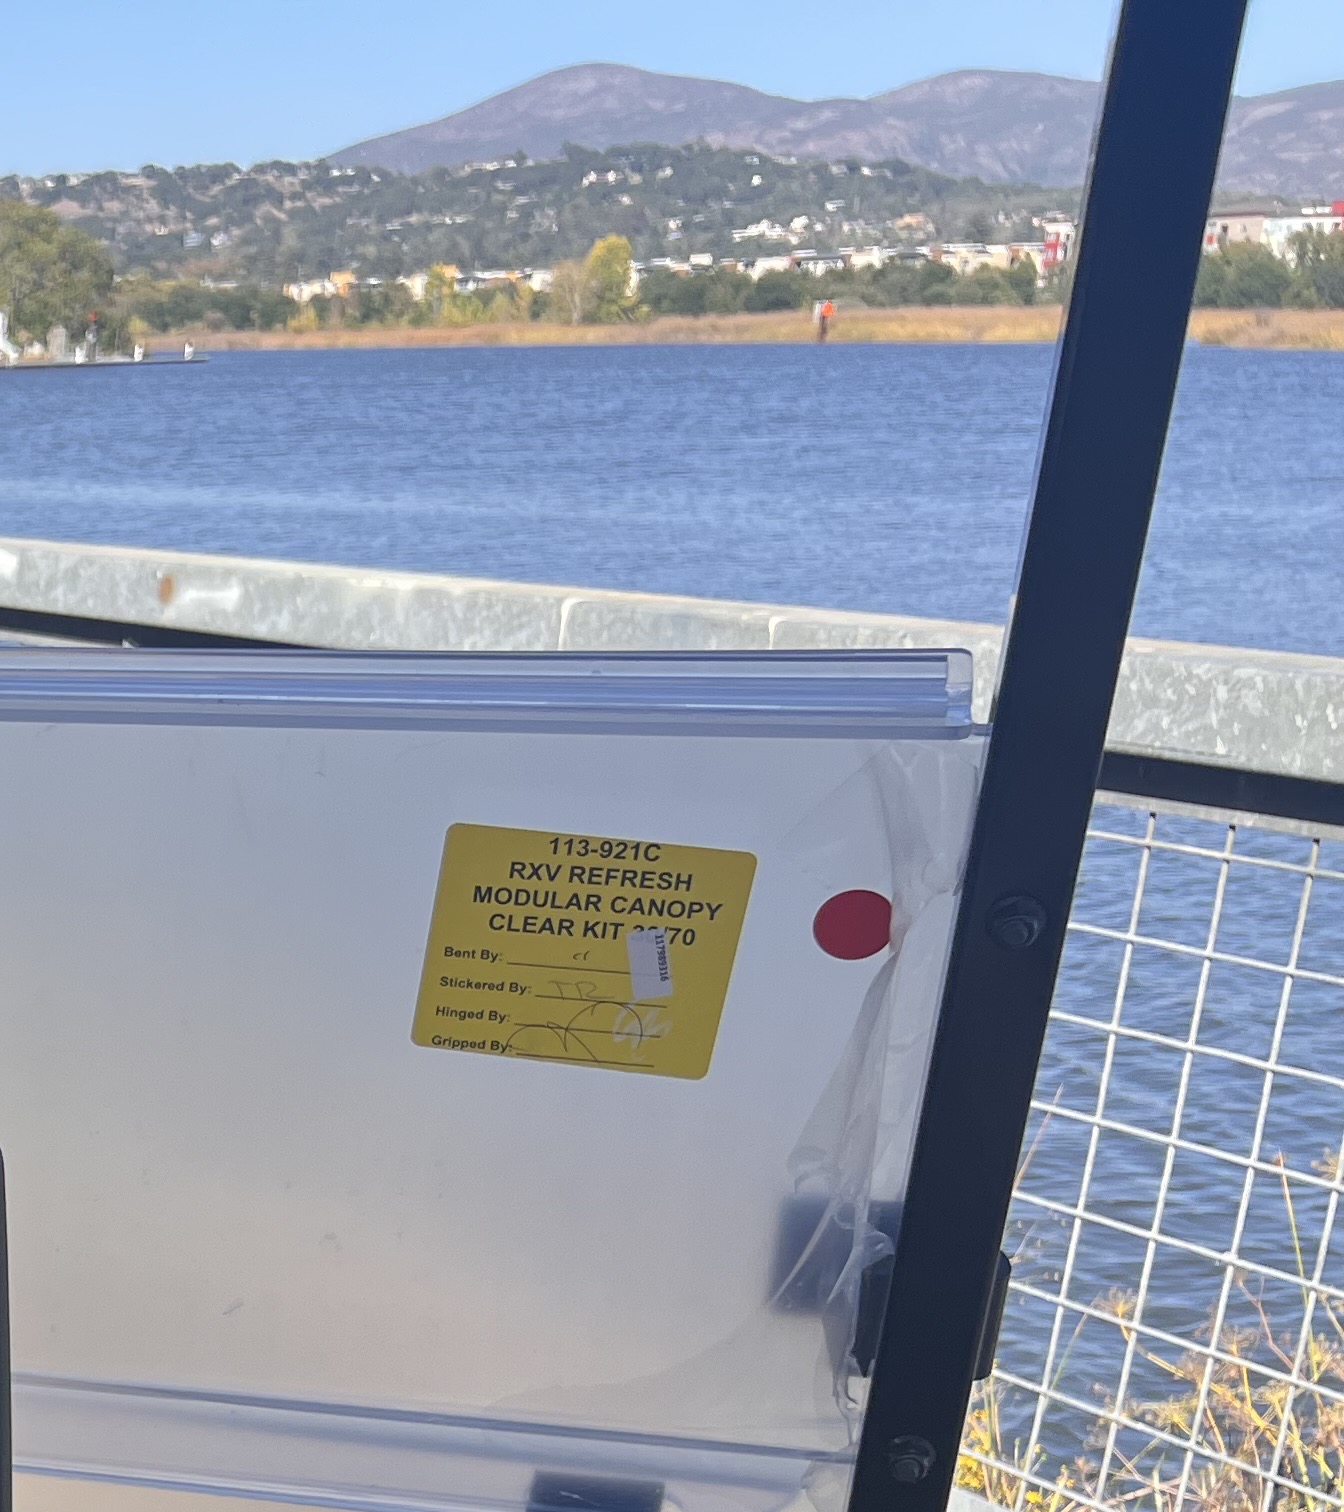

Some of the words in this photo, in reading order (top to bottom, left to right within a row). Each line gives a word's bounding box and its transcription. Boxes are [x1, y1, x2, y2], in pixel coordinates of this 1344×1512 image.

[549, 837, 661, 862] 113-921C
[509, 861, 561, 882] RXV
[568, 866, 693, 892] REFRESH
[472, 886, 602, 912] MODULAR
[610, 896, 723, 921] CANOPY
[488, 913, 574, 937] CLEAR
[582, 922, 624, 941] KIT
[444, 946, 477, 960] Bent
[440, 976, 505, 992] Stickered
[435, 1006, 484, 1021] Hinged
[431, 1035, 486, 1051] Gripped
